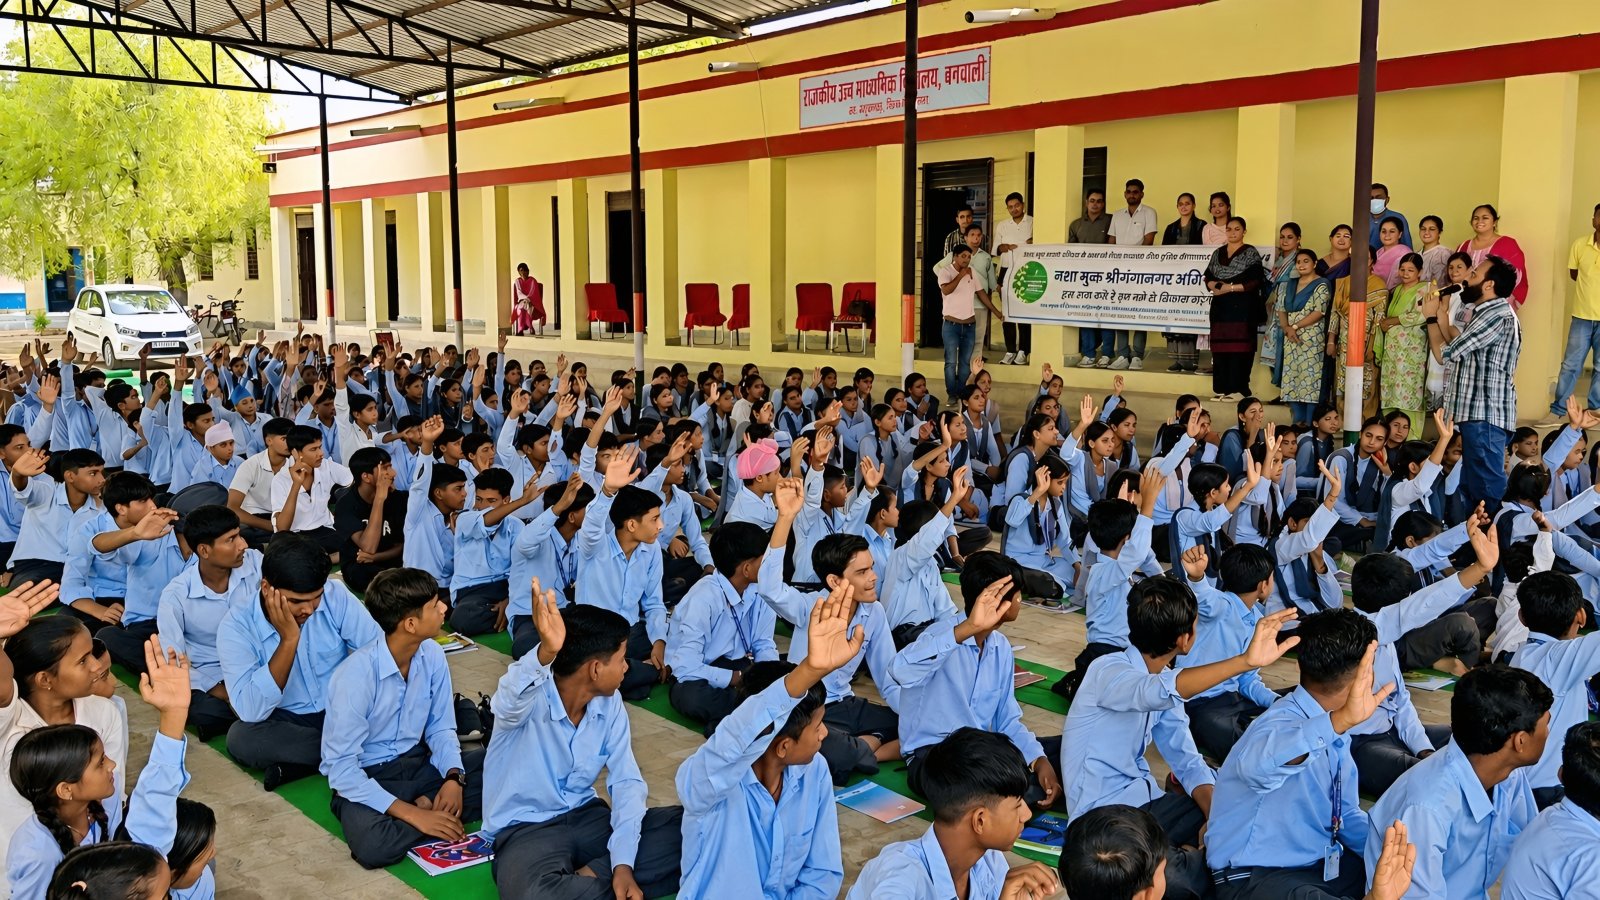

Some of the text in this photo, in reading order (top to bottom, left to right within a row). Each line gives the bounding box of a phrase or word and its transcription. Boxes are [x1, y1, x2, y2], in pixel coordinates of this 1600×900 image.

[804, 80, 837, 107] राजकीय
[856, 71, 897, 99] माध्यमिक
[944, 54, 987, 85] बनवाली
[1054, 270, 1079, 283] नशा
[1080, 271, 1104, 287] मुक्त
[1105, 268, 1174, 285] श्रीगंगानगर
